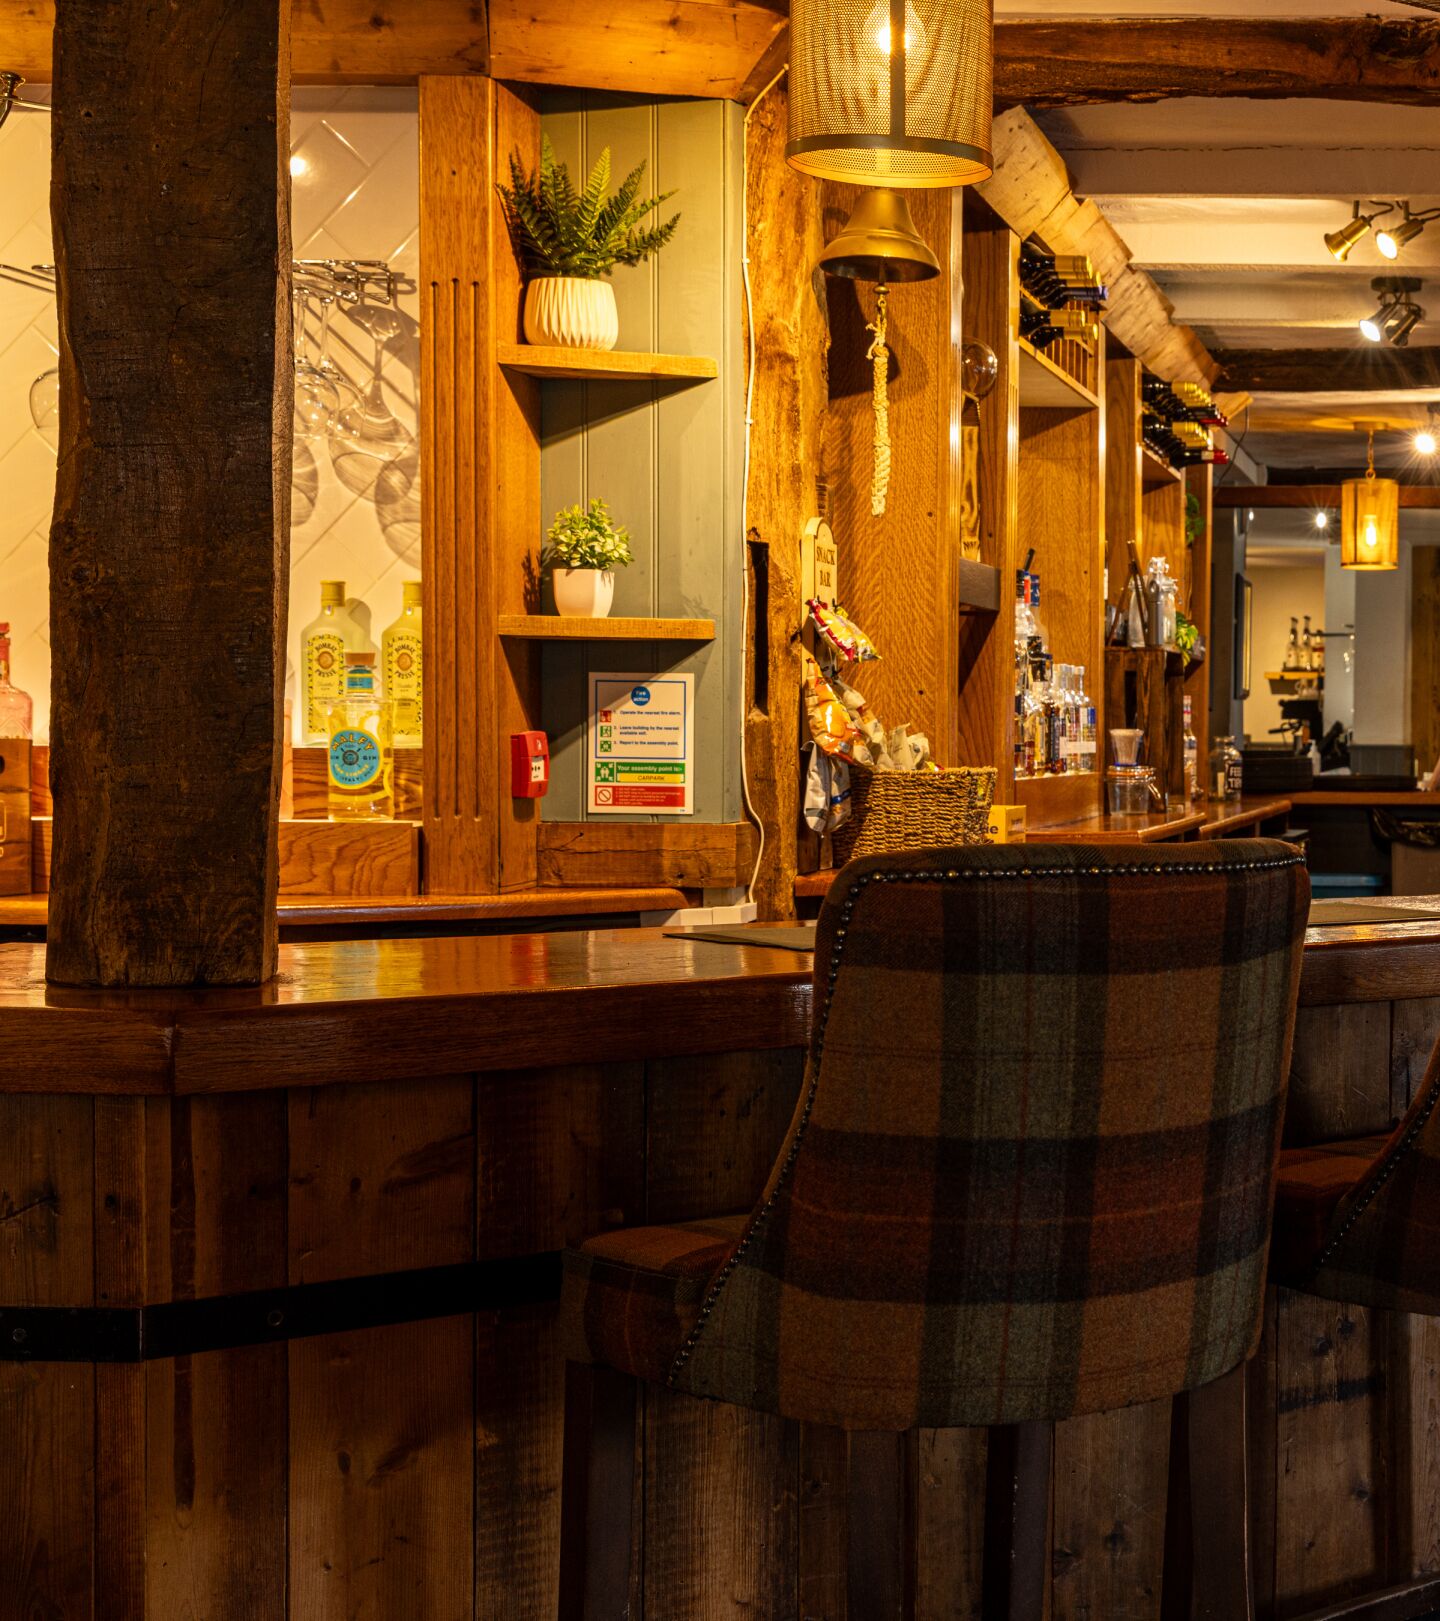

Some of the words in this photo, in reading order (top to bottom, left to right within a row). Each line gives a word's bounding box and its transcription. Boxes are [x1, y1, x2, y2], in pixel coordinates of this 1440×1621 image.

[816, 546, 835, 565] SNACK
[819, 569, 831, 587] BAR
[315, 642, 337, 652] BOMBAY
[394, 643, 416, 653] BOMBAY
[331, 733, 375, 751] MALFY
